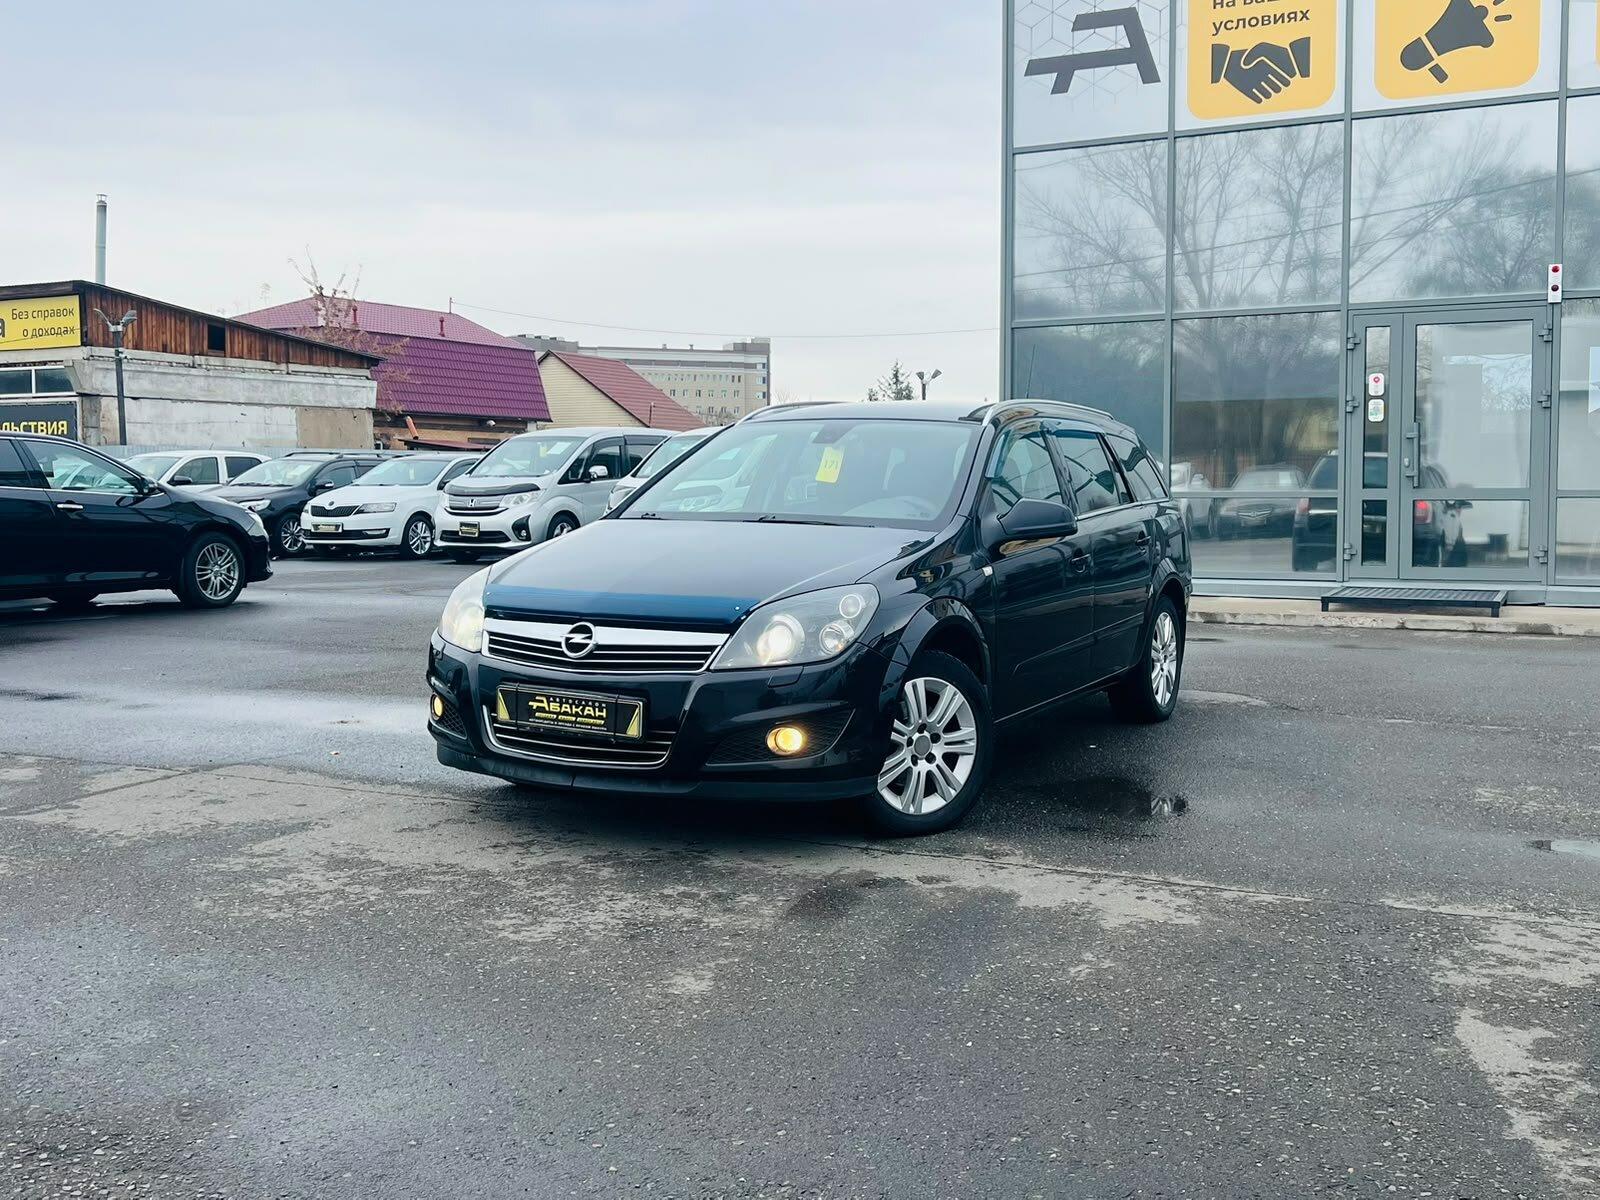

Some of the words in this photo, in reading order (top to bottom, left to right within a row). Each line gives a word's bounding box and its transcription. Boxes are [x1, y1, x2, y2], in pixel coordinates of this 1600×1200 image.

[1212, 9, 1310, 36] условиях
[11, 308, 29, 320] Без
[31, 308, 75, 321] справок
[22, 328, 29, 337] о
[31, 326, 75, 339] доходах
[528, 695, 607, 718] АБАКАН
